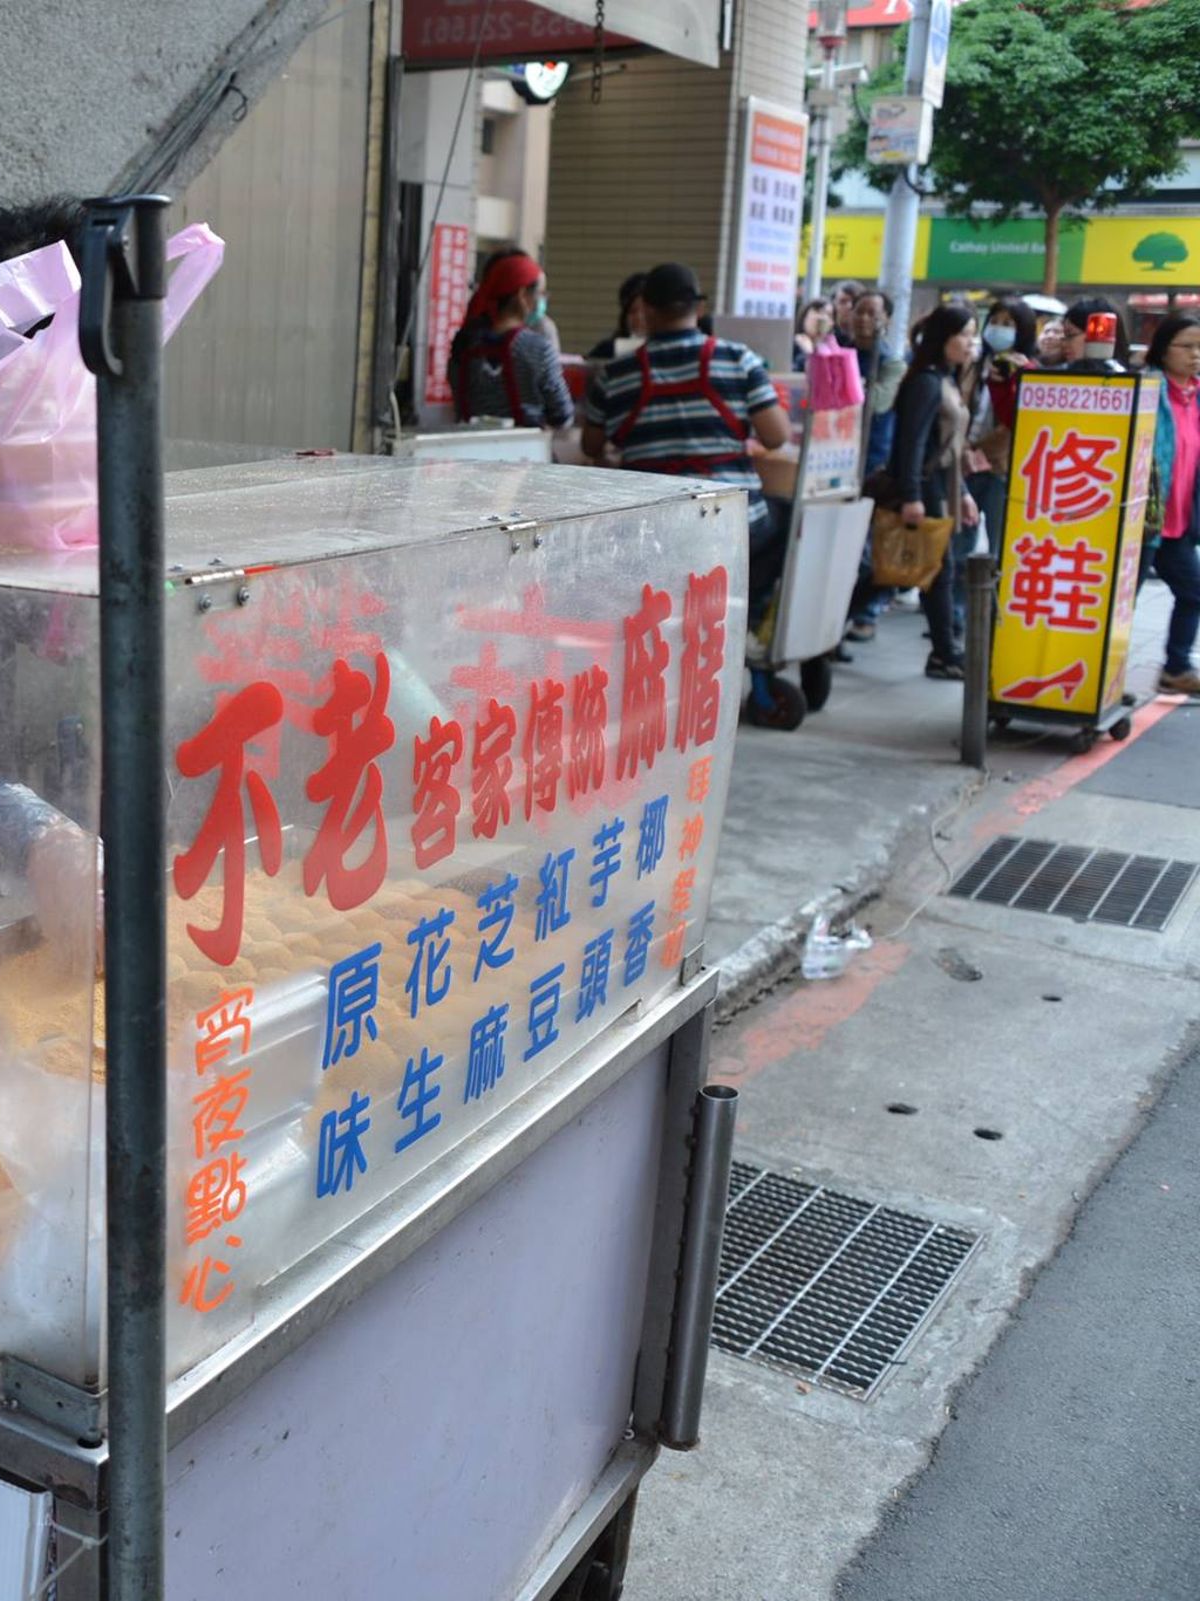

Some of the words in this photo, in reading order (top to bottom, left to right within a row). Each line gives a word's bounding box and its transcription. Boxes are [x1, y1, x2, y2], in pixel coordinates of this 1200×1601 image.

[1022, 386, 1131, 411] 0958221661
[1008, 429, 1118, 631] 修鞋
[394, 908, 456, 1154] 花生
[464, 873, 520, 1103] 芝麻
[524, 848, 577, 1062] 紅豆
[576, 818, 626, 1022] 芋頭
[179, 986, 254, 1312] 宵夜點心
[316, 943, 383, 1199] 原味
